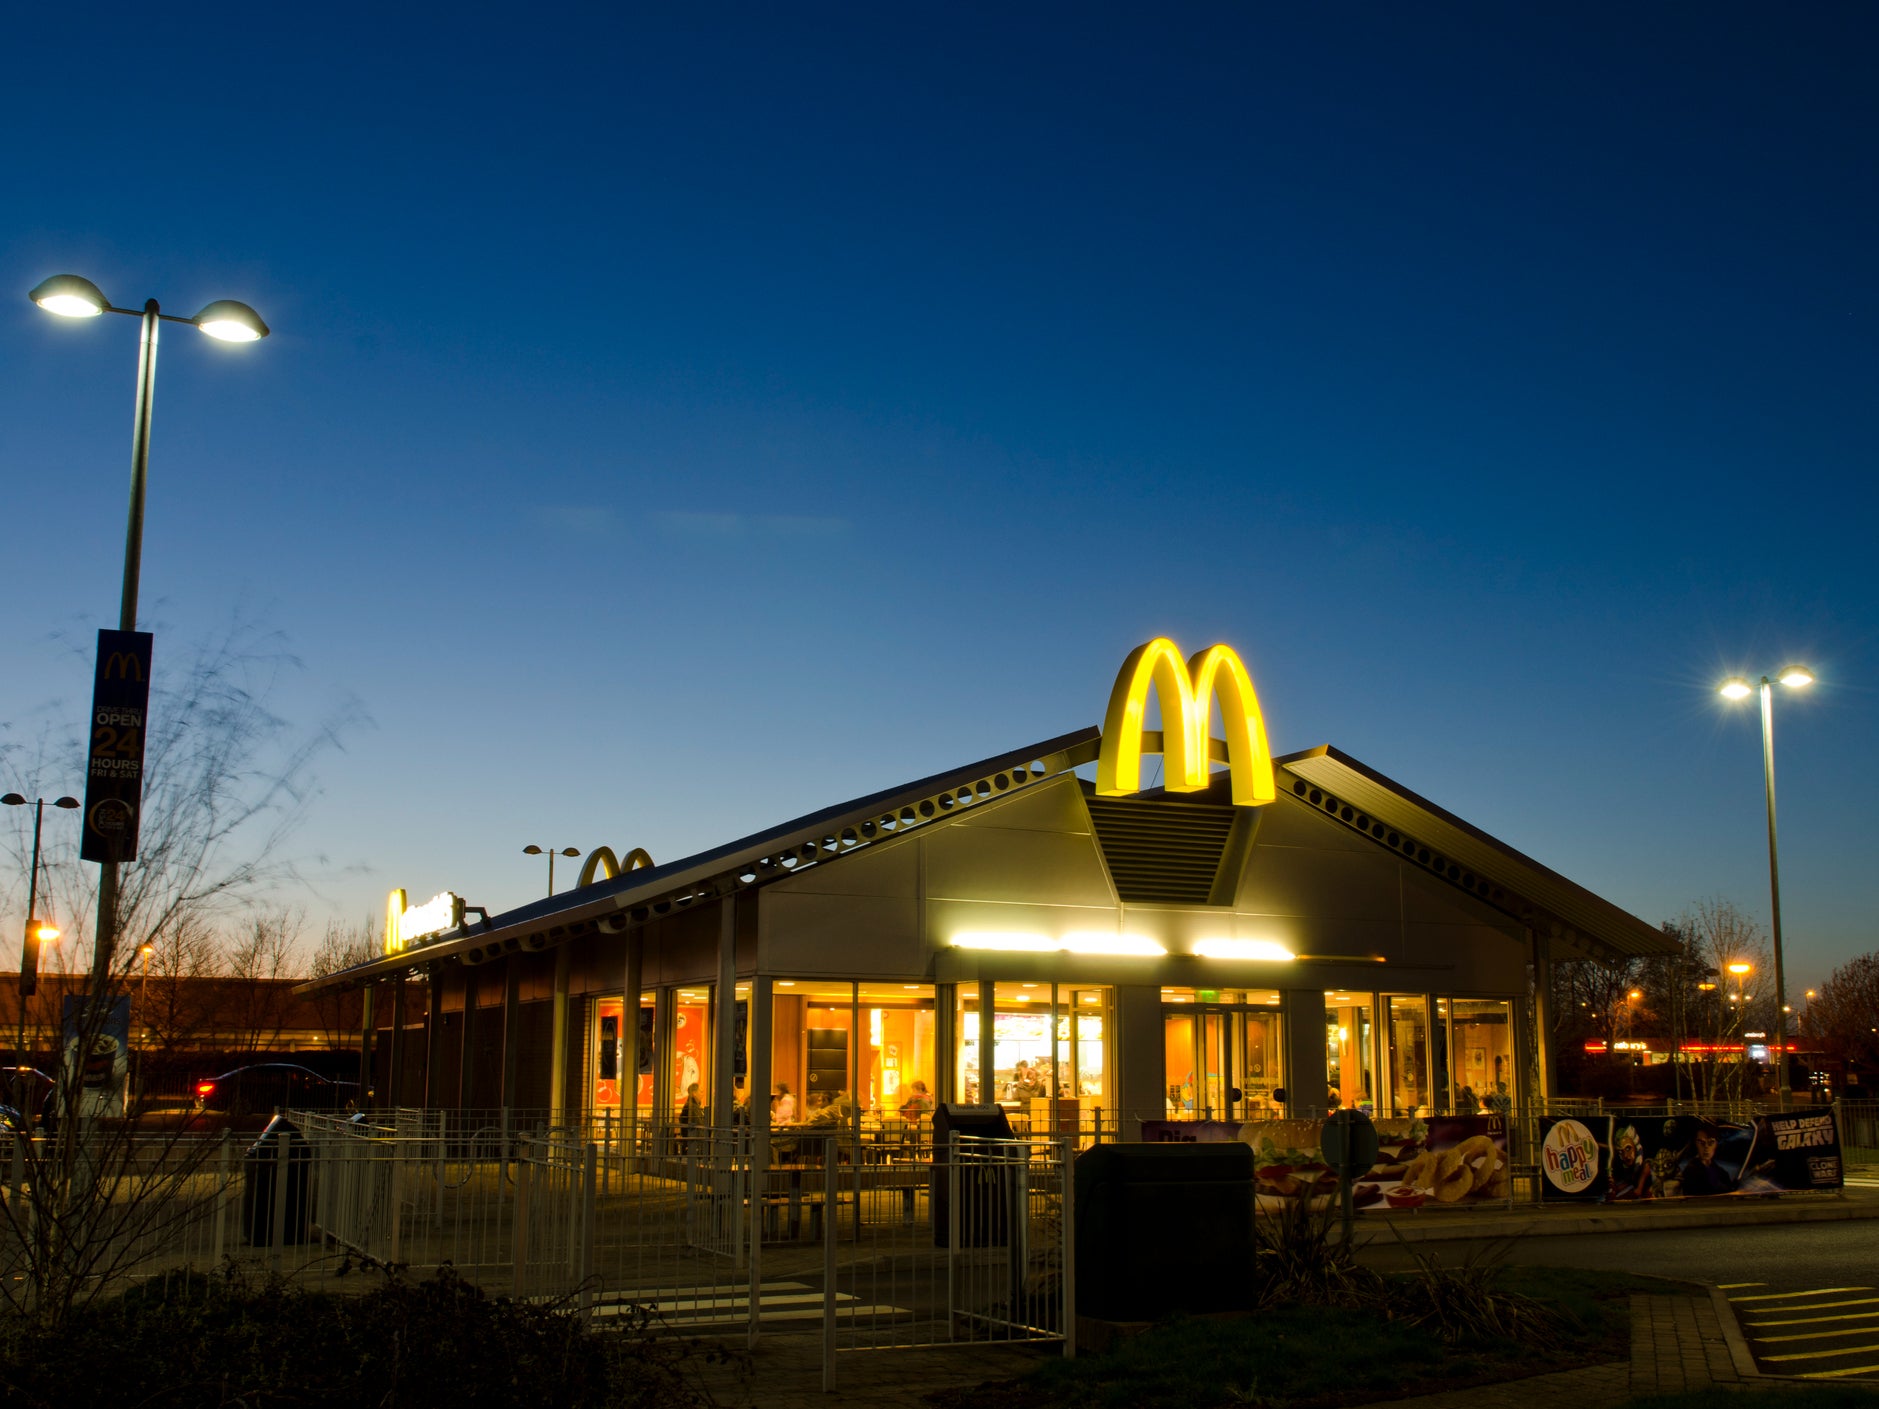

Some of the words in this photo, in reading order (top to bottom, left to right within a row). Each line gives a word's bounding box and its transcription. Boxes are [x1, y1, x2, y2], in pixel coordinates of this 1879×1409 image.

[97, 712, 142, 728] OPEN
[92, 726, 139, 759] 24
[92, 757, 139, 770] HOURS
[91, 768, 107, 778] FRI
[110, 769, 117, 778] &
[120, 770, 139, 779] SAT
[1771, 1119, 1798, 1131] HELP
[1777, 1129, 1834, 1150] GALAXY
[1545, 1138, 1594, 1170] happy
[1563, 1164, 1590, 1184] meal
